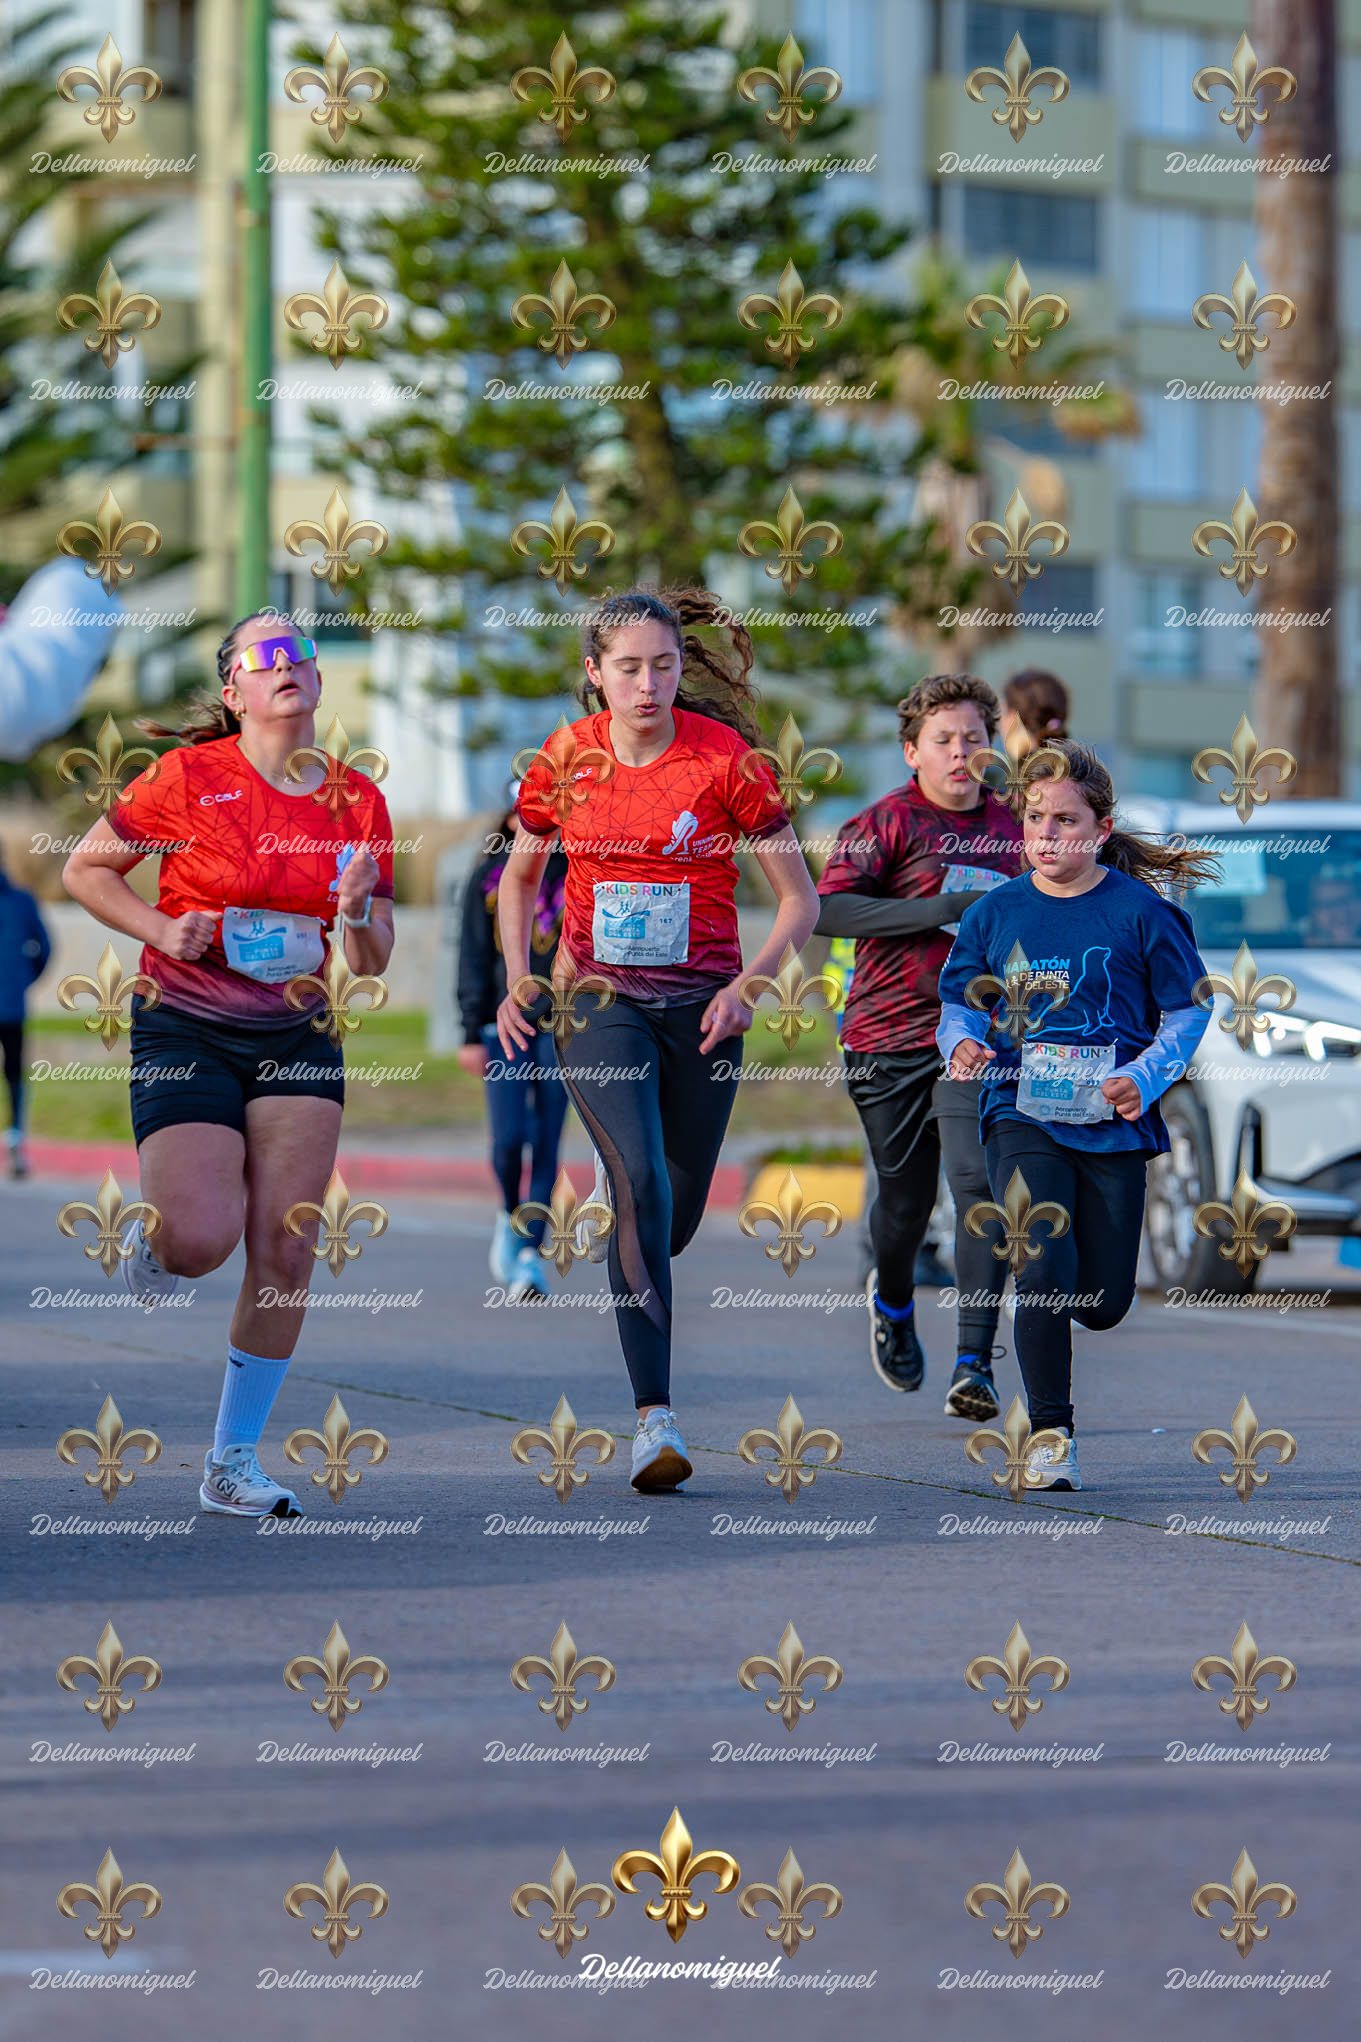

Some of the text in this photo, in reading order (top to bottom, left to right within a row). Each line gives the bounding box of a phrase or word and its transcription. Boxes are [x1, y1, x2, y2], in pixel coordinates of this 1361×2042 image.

[957, 868, 982, 880] KIDS
[606, 883, 673, 897] KIDS RUN
[1019, 970, 1070, 982] DE PUNTA
[1025, 980, 1070, 990] DEL ESTE
[1035, 1044, 1100, 1059] KIDS RUN
